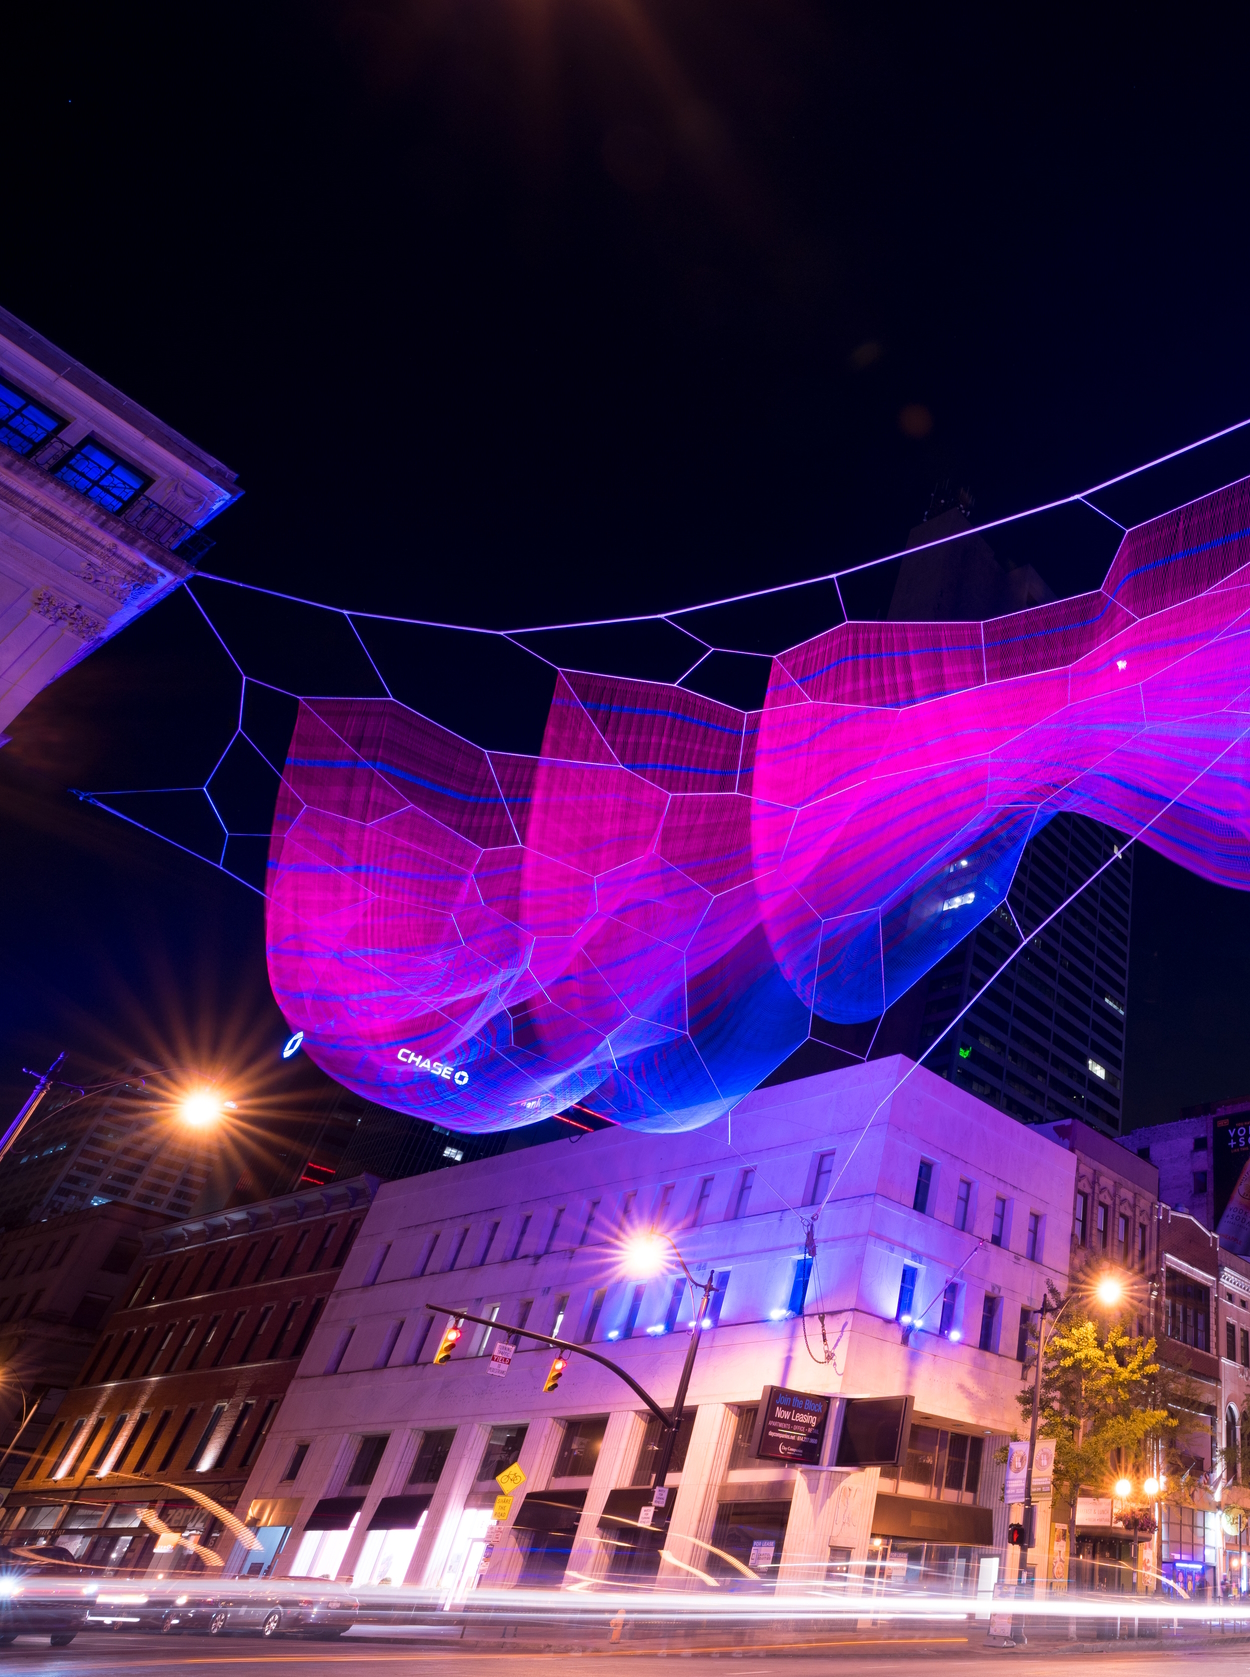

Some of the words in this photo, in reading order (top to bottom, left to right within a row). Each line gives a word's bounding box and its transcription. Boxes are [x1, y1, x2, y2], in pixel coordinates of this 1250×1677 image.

[397, 1048, 454, 1080] CHASE
[493, 1356, 510, 1364] YIELD
[775, 1393, 791, 1406] Join
[792, 1396, 803, 1409] the
[804, 1399, 823, 1413] Block
[775, 1406, 791, 1420] Now
[791, 1410, 817, 1427] Leasing
